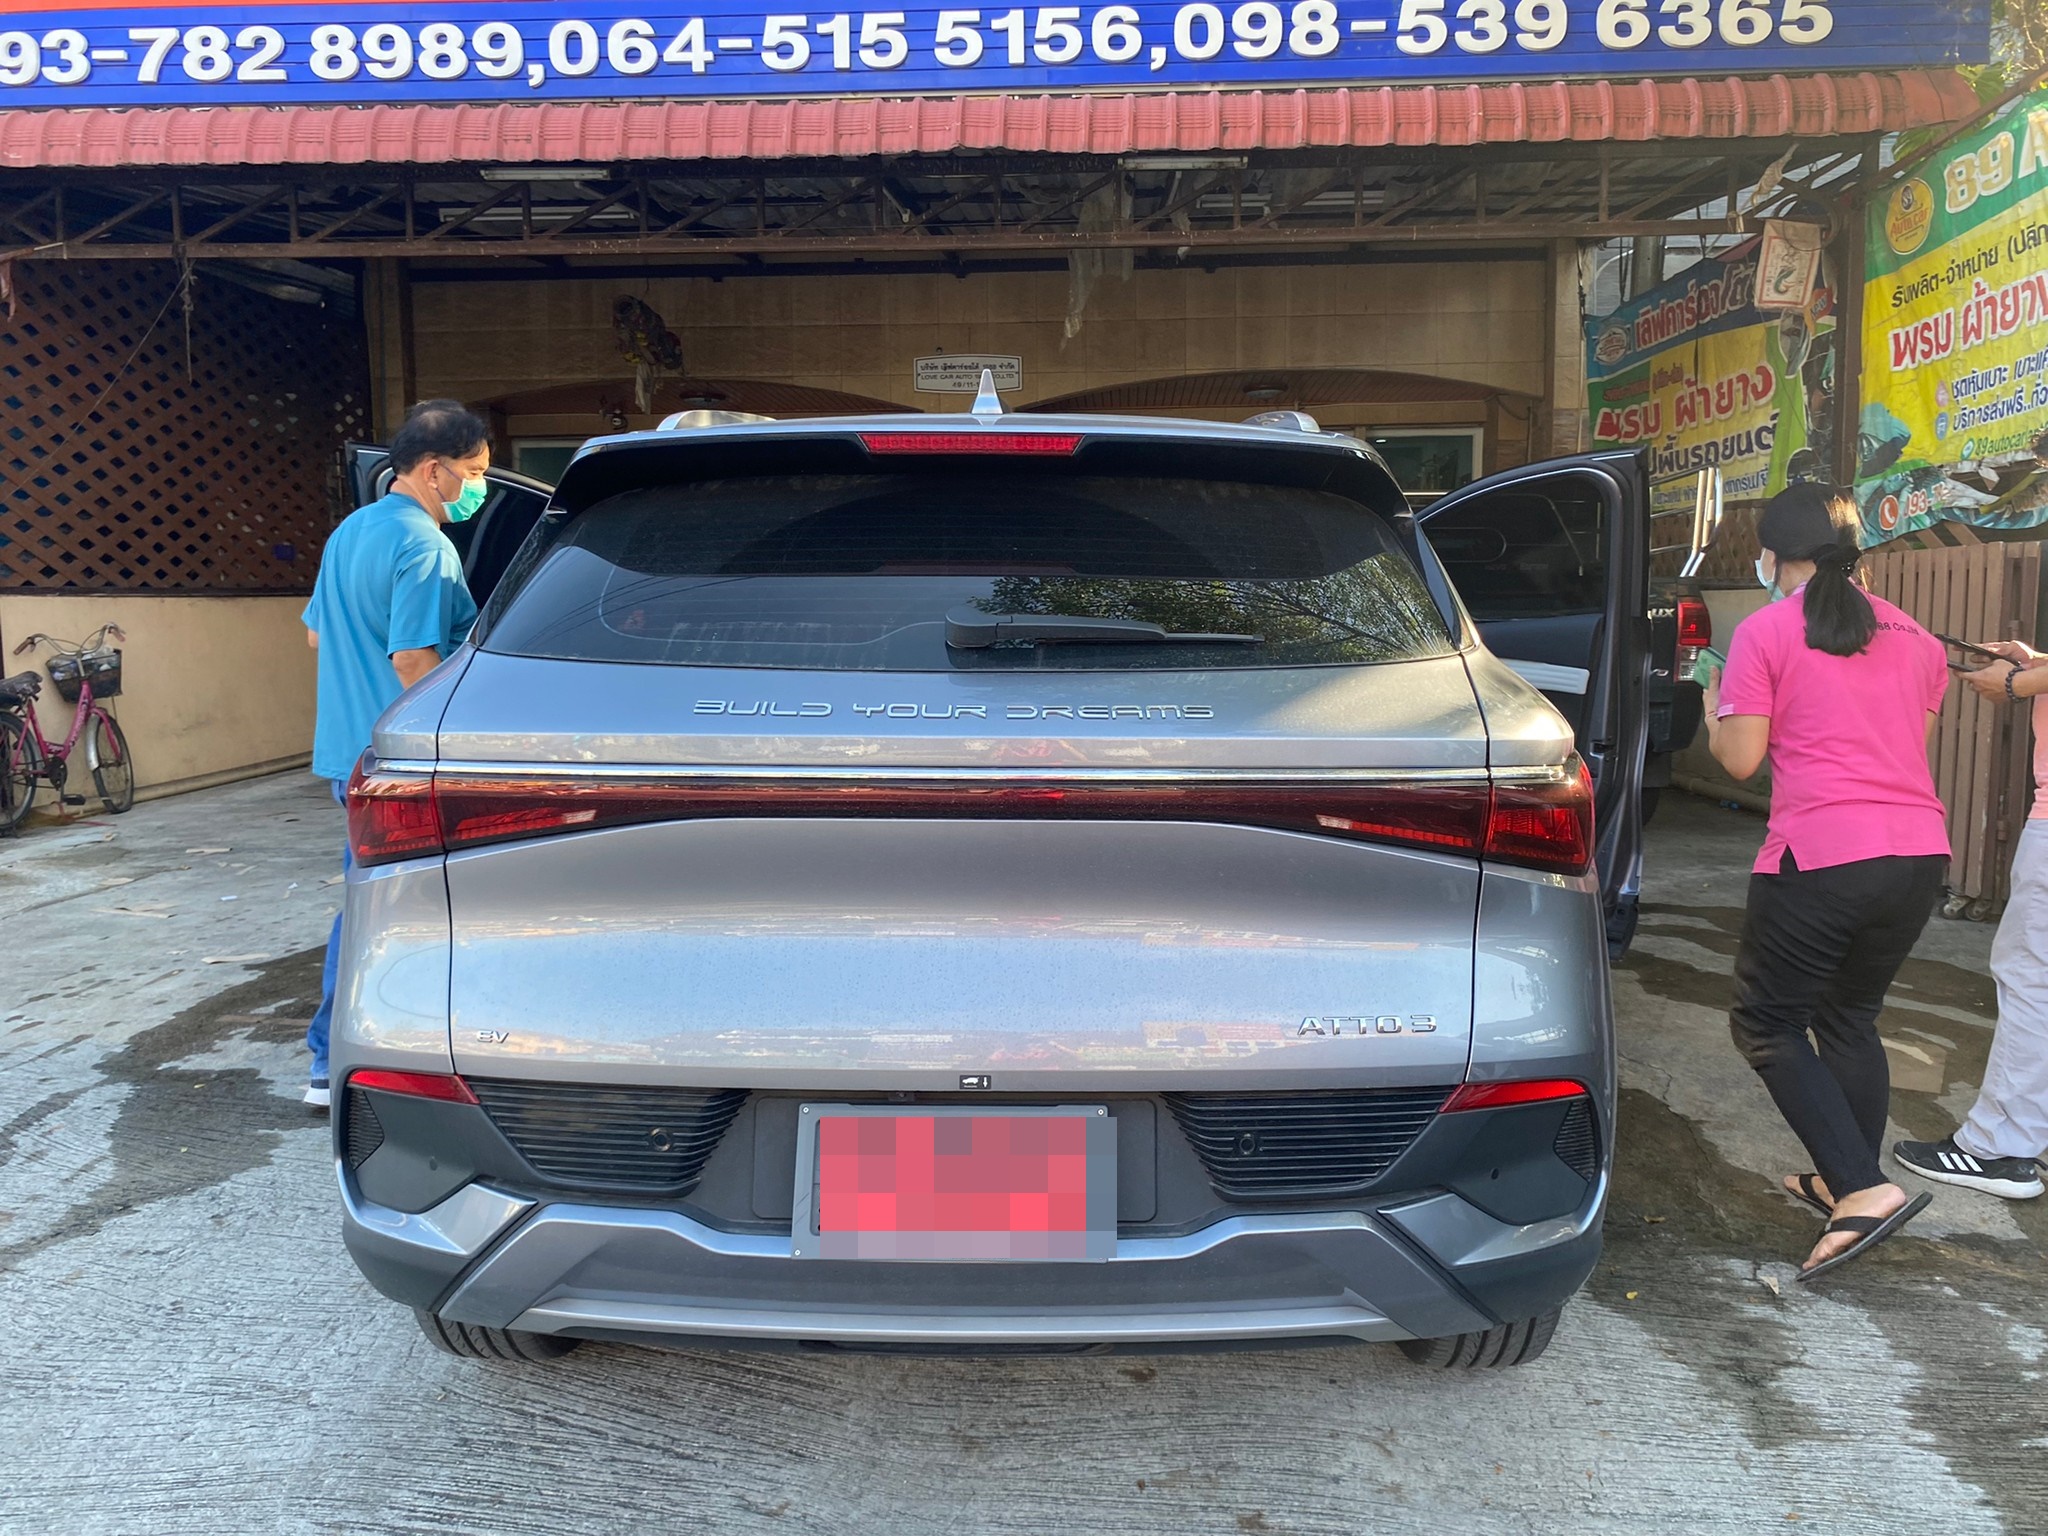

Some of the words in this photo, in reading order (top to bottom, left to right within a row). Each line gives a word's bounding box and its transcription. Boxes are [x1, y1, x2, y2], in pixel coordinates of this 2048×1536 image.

[309, 12, 908, 88] 8989,064-515
[934, 0, 1568, 71] 5156,098-539
[1596, 0, 1834, 50] 6365
[1944, 131, 2015, 213] 89
[1892, 311, 1953, 368] พรม
[1676, 364, 1774, 428] ผ้ายาง
[693, 699, 834, 718] BUILD
[852, 702, 988, 720] YOUR
[1006, 704, 1215, 721] DREAMS
[476, 1029, 510, 1044] EV
[1297, 1014, 1403, 1036] ATTO
[1410, 1013, 1438, 1034] 3
